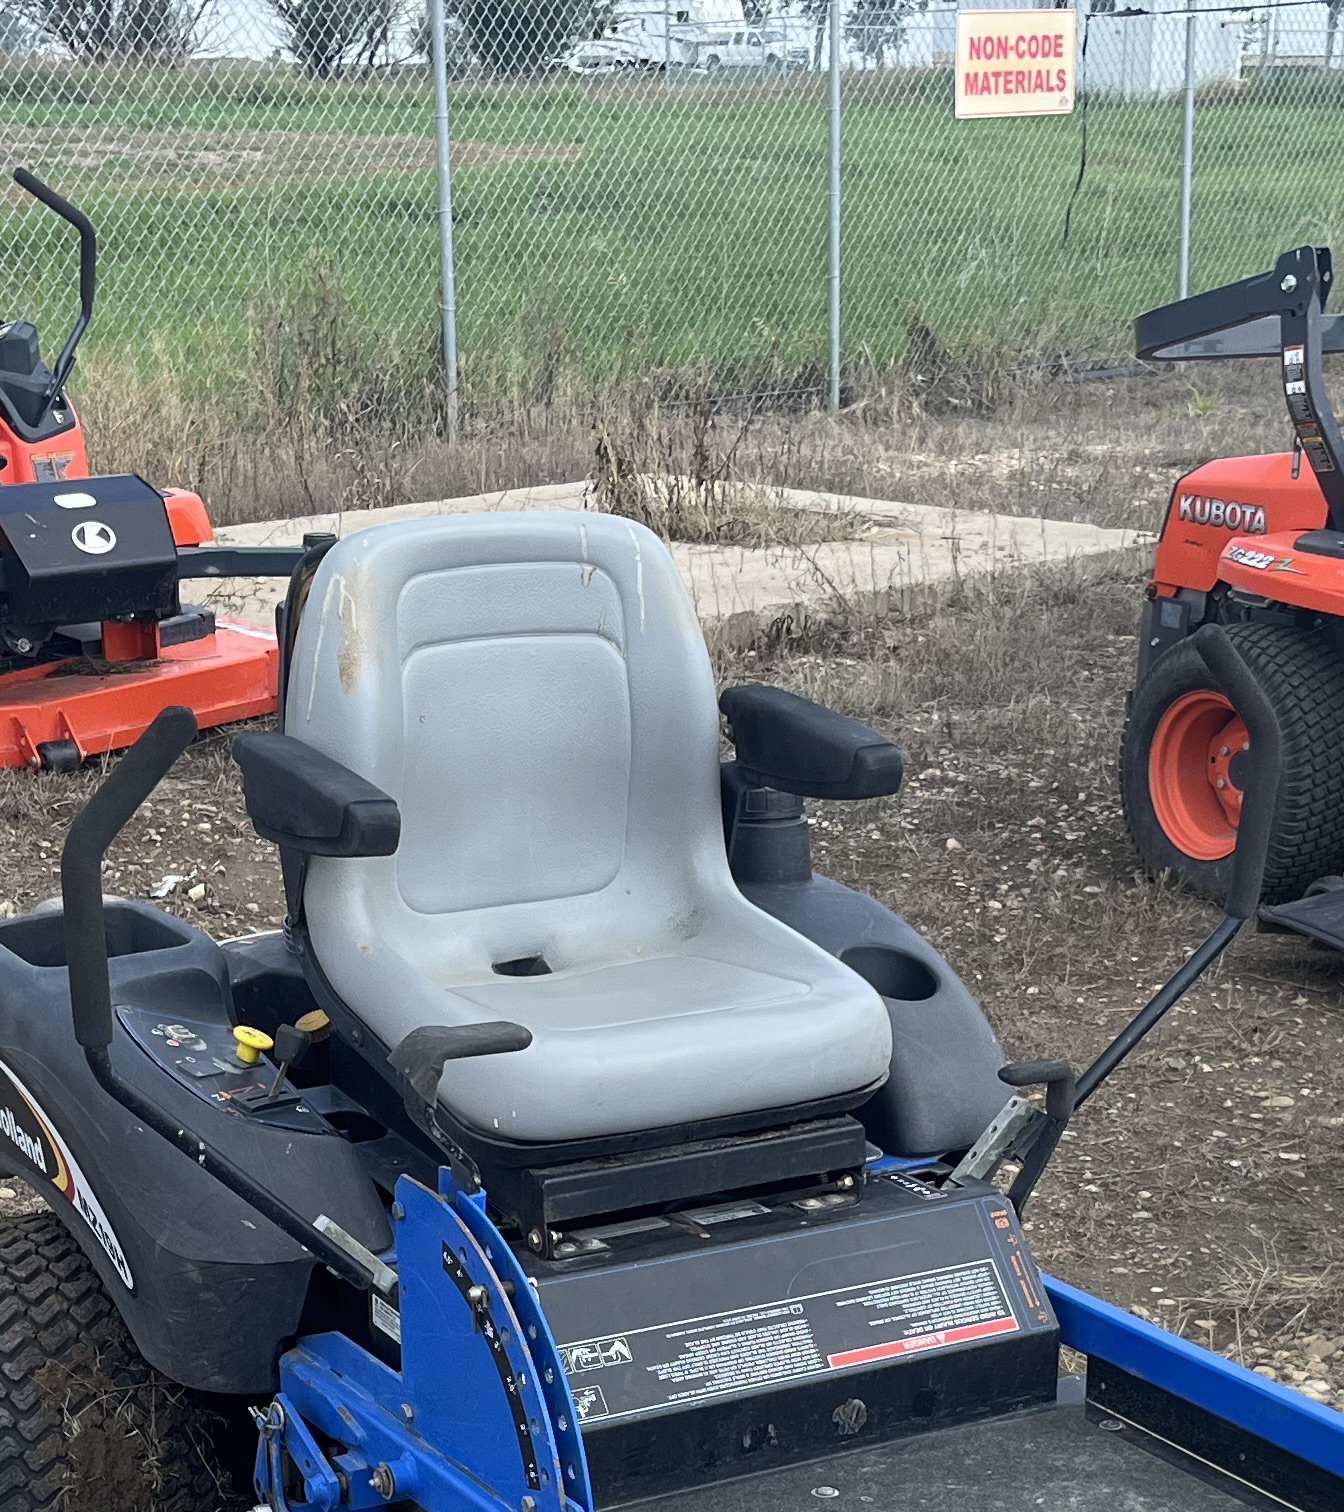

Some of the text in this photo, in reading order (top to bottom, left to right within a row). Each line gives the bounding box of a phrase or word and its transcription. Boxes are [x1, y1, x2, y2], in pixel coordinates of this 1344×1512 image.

[969, 34, 1065, 60] NON-CODE
[964, 69, 1067, 96] MATERIALS
[1178, 493, 1267, 535] KUBOTA
[1226, 545, 1275, 569] ZG222
